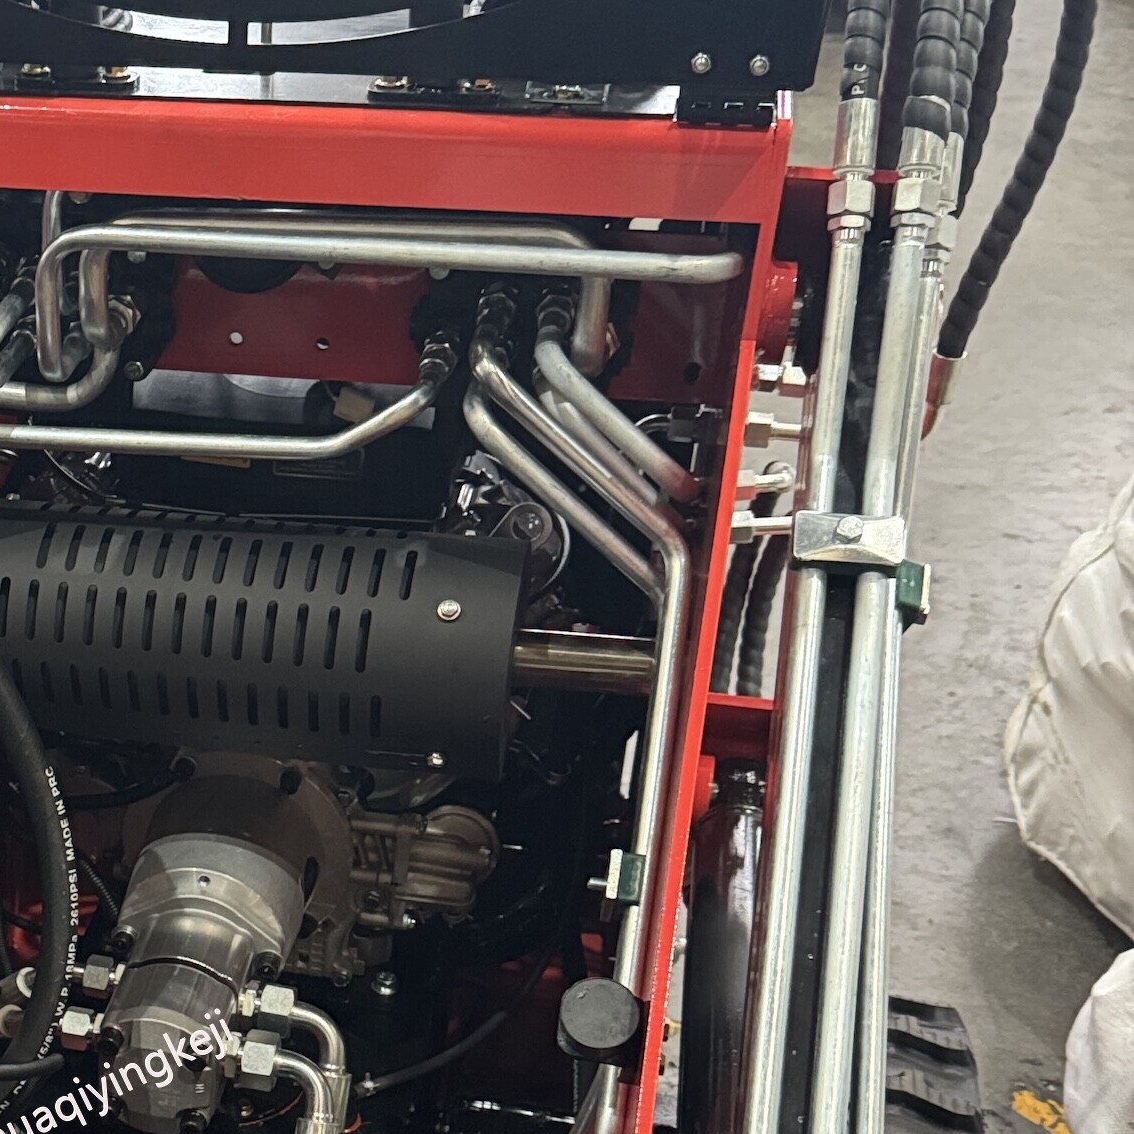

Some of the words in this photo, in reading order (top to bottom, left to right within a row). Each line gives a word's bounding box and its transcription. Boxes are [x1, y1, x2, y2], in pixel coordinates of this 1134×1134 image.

[851, 64, 866, 95] PC
[45, 766, 60, 797] PRC
[55, 799, 66, 815] IN
[60, 817, 75, 861] MADE
[68, 869, 79, 927] 2610PSI
